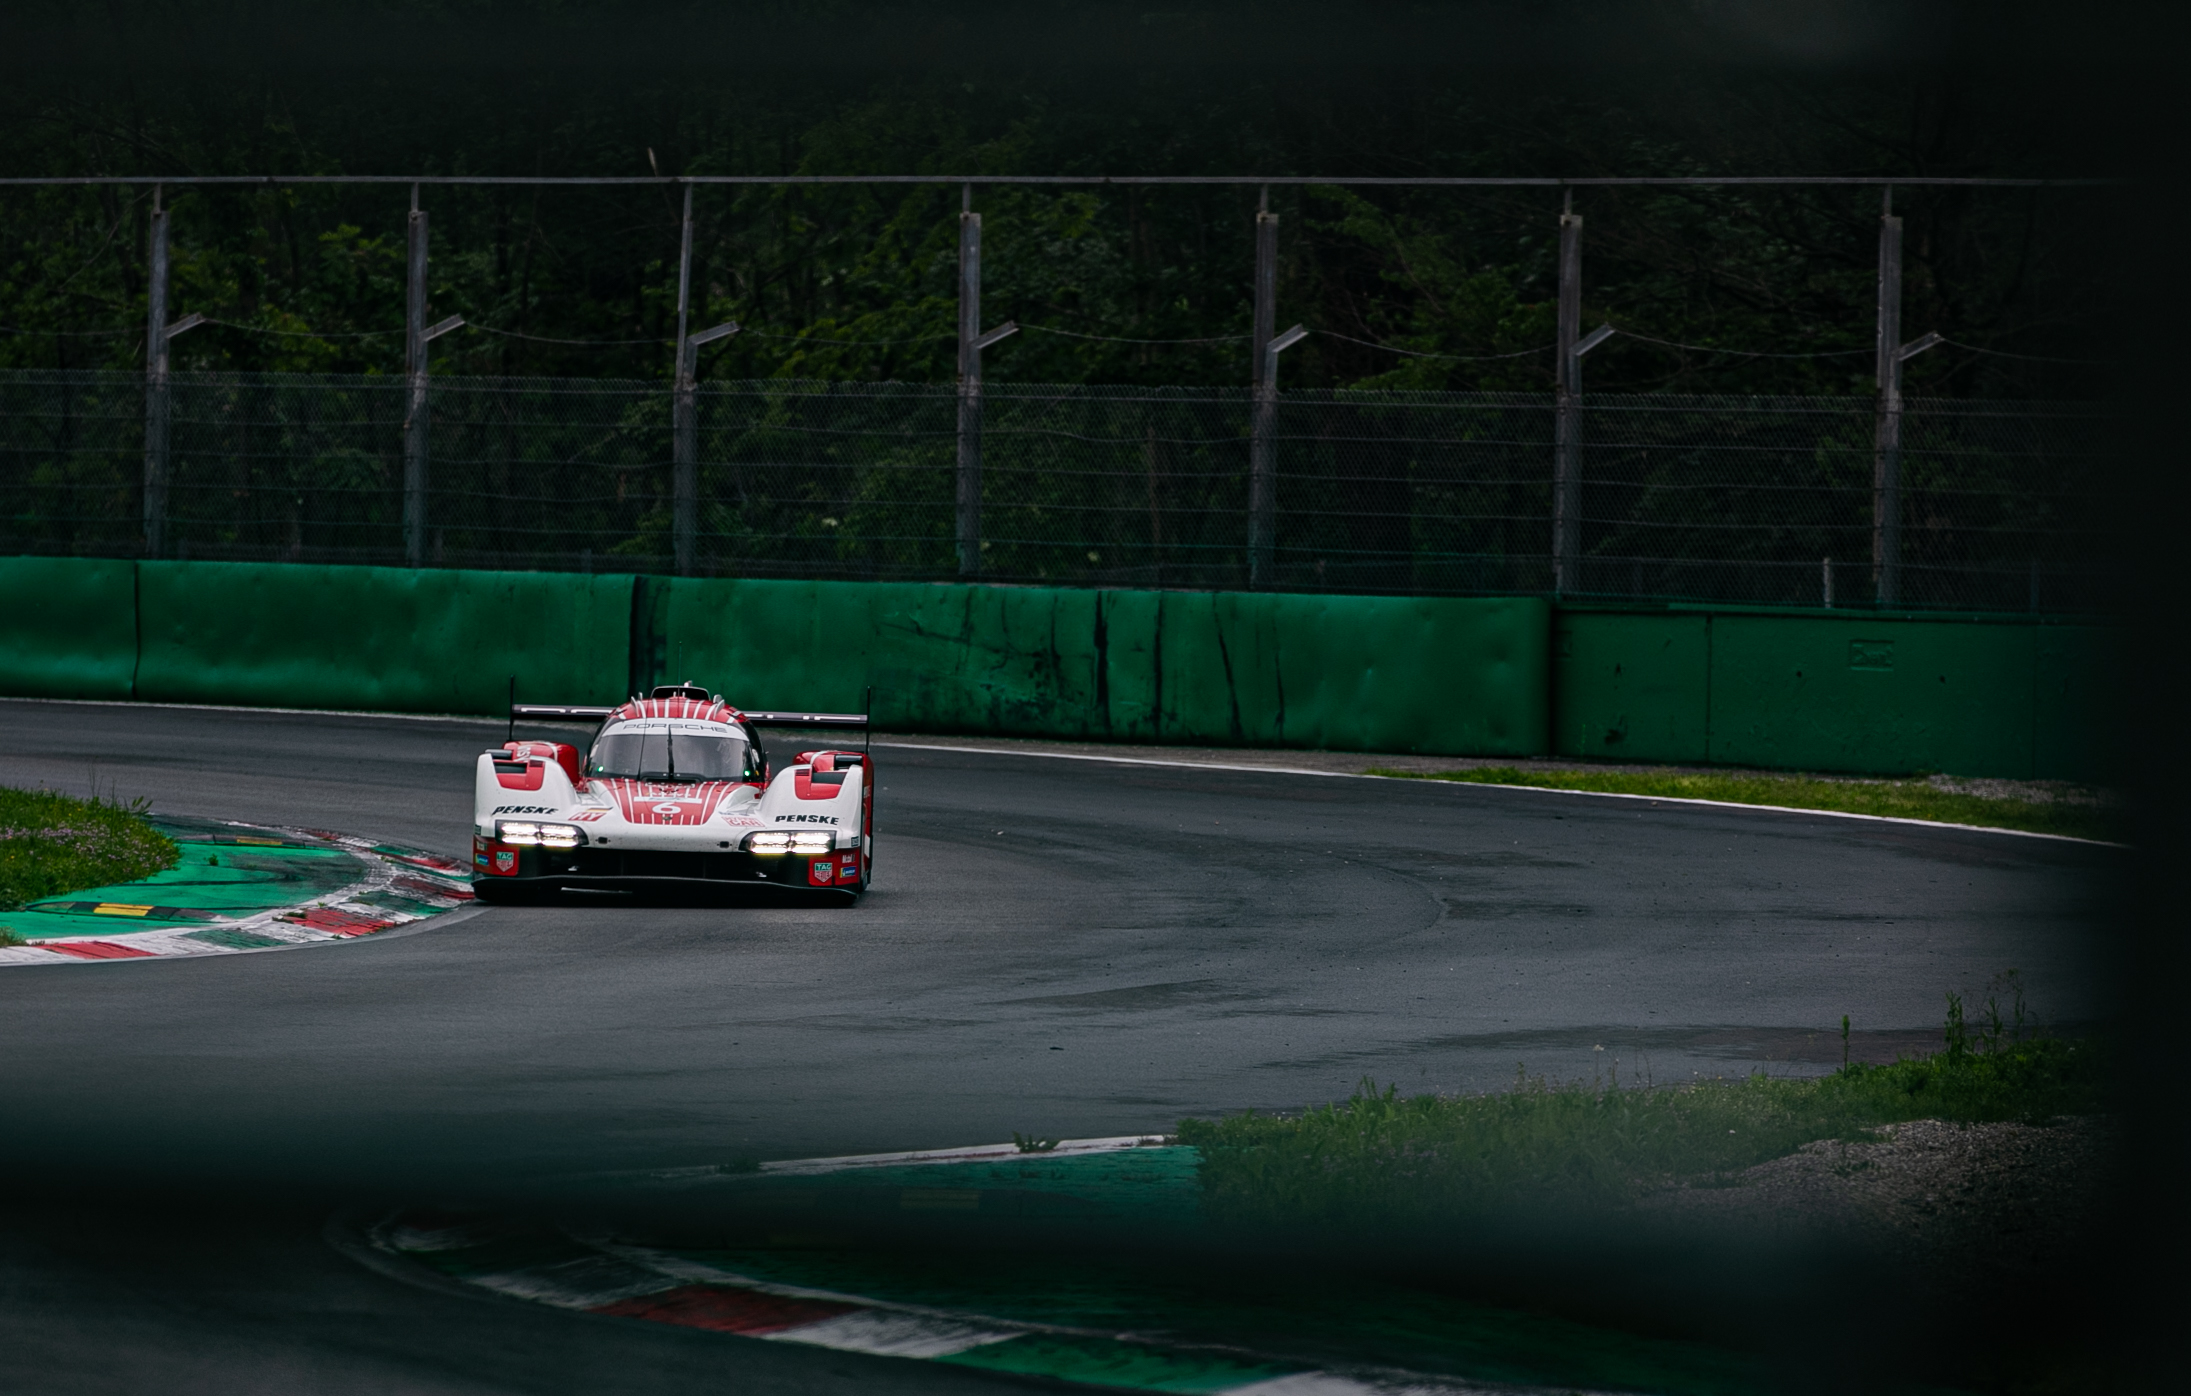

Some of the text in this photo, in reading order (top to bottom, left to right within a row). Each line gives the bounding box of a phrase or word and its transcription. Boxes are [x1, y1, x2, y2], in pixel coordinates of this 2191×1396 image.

[623, 723, 728, 733] PORSCHE
[491, 806, 558, 815] PENSKE
[652, 802, 682, 814] 6
[775, 815, 840, 825] PENSKE
